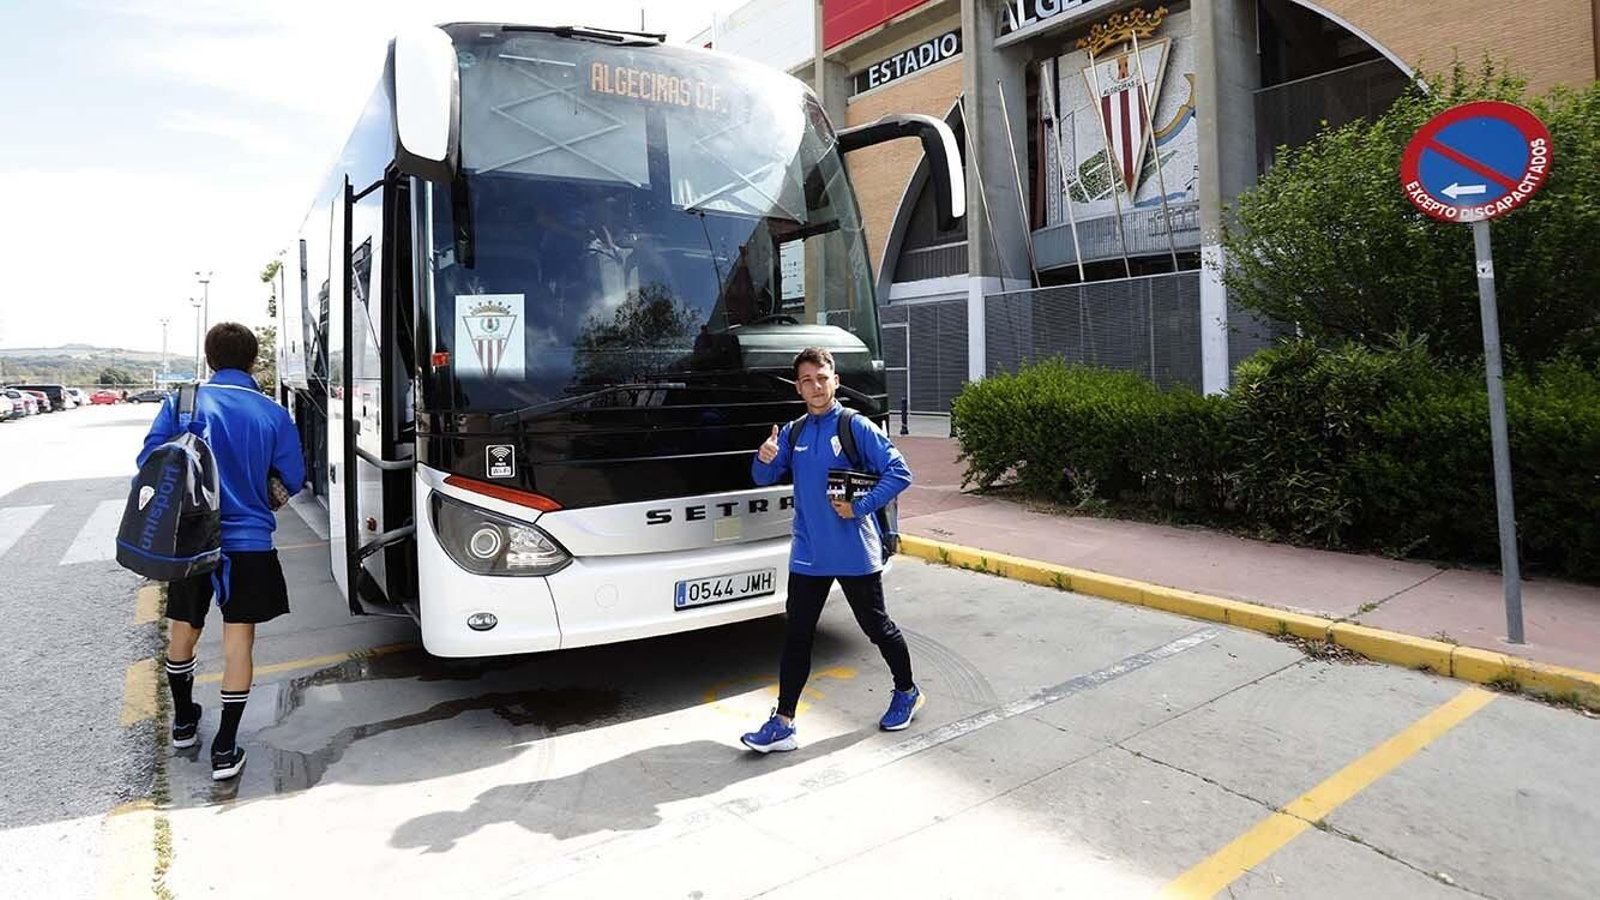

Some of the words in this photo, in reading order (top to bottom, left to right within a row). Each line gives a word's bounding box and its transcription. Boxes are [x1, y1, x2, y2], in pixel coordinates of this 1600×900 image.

[591, 62, 691, 106] ALGECIRAS
[866, 34, 958, 88] ESTADIO
[1406, 181, 1457, 218] EXCEPTO
[1460, 138, 1547, 219] DISCAPACITADOS
[688, 581, 734, 601] 0544
[740, 572, 772, 594] JMH
